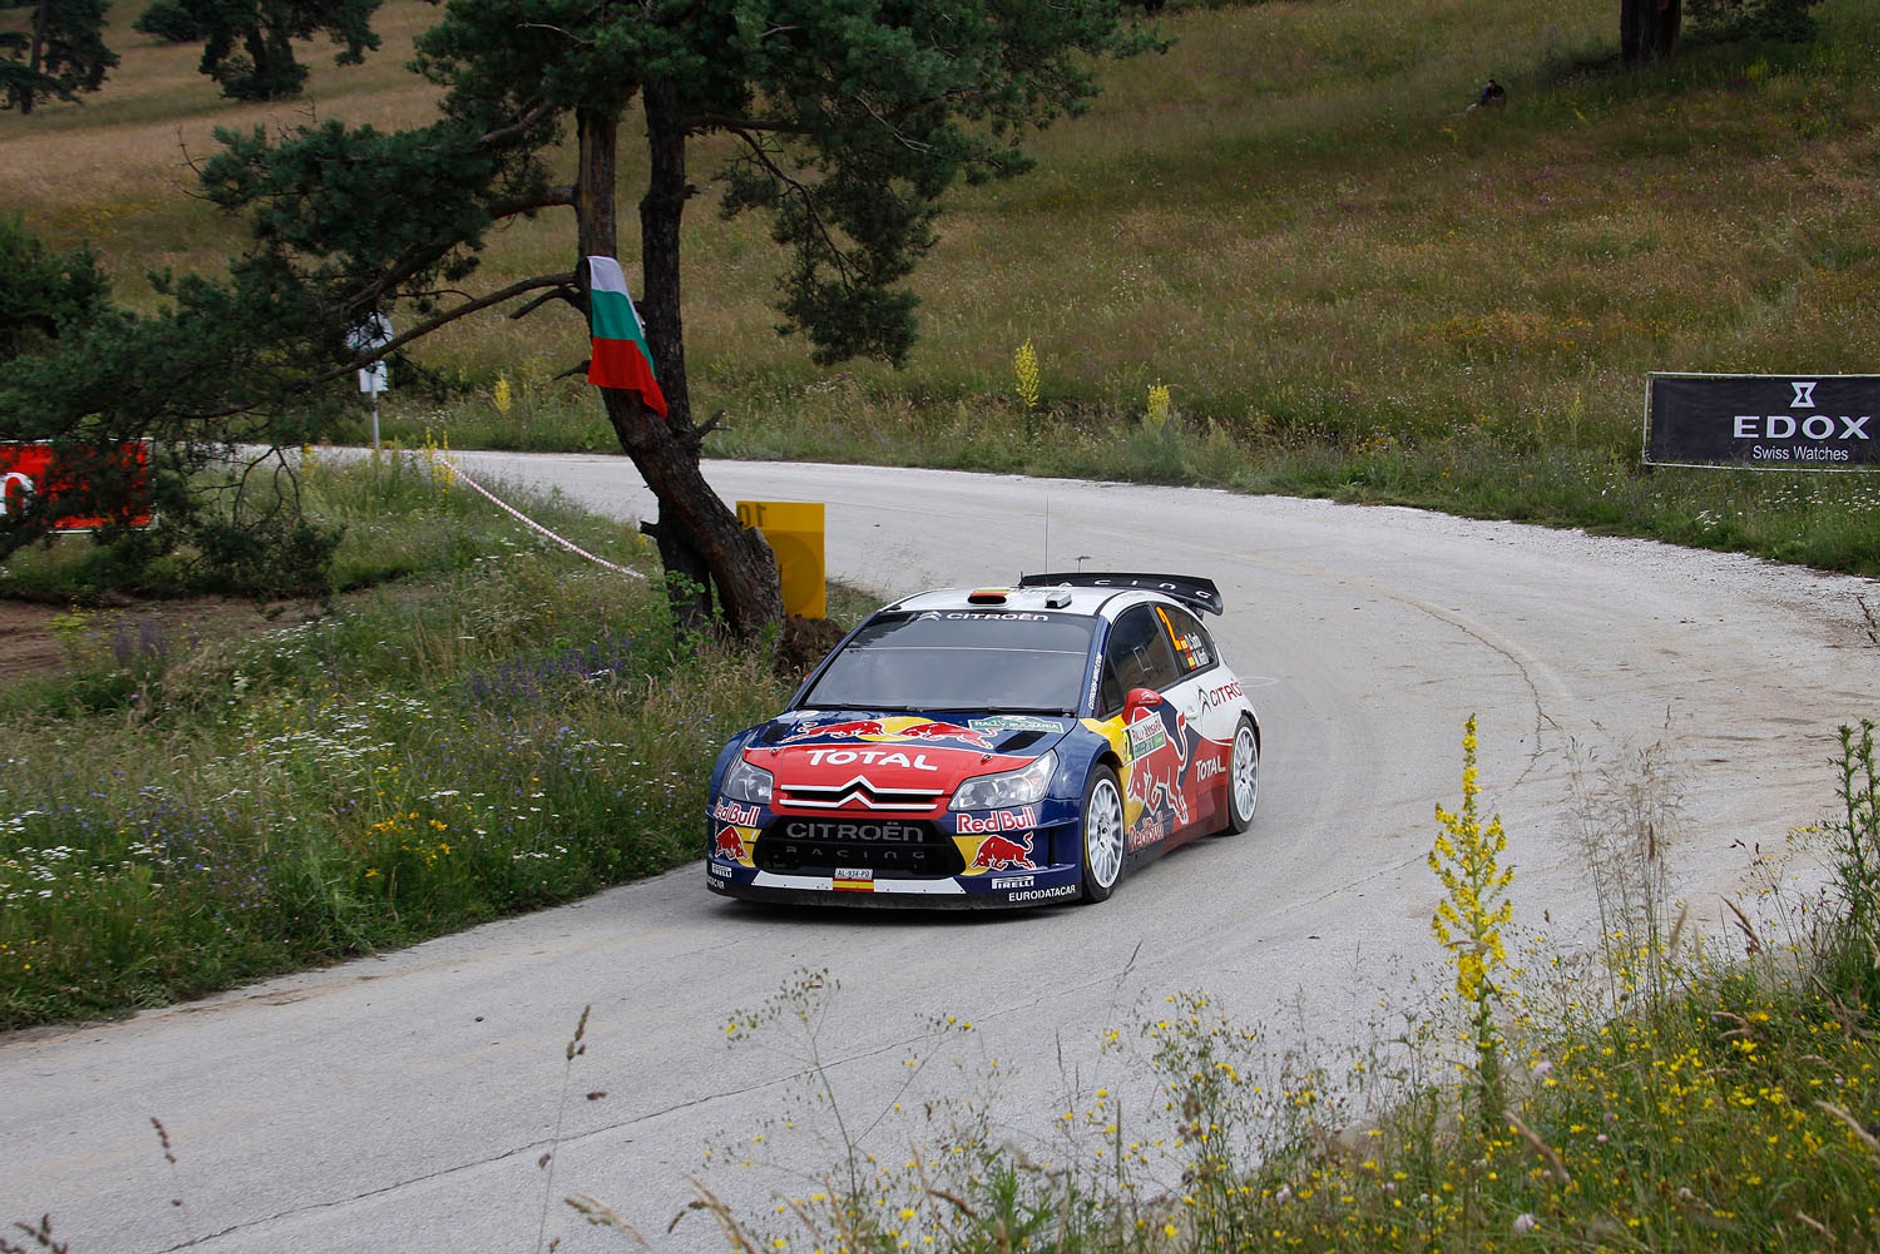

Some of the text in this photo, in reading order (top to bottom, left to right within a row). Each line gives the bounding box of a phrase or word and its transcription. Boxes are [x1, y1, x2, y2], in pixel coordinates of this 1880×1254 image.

[1733, 415, 1871, 439] EDOX
[1753, 445, 1848, 461] Swiss Watches
[1057, 579, 1212, 599] ACING
[1156, 606, 1182, 651] 2
[1210, 679, 1242, 707] CITRO
[807, 750, 937, 771] TOTAL
[1196, 756, 1226, 783] TOTAL
[728, 803, 761, 828] Bull
[957, 806, 1038, 834] Red Bull
[786, 845, 925, 859] RACING
[991, 876, 1034, 889] PIRELLI
[1008, 884, 1076, 902] EURODATACAR
